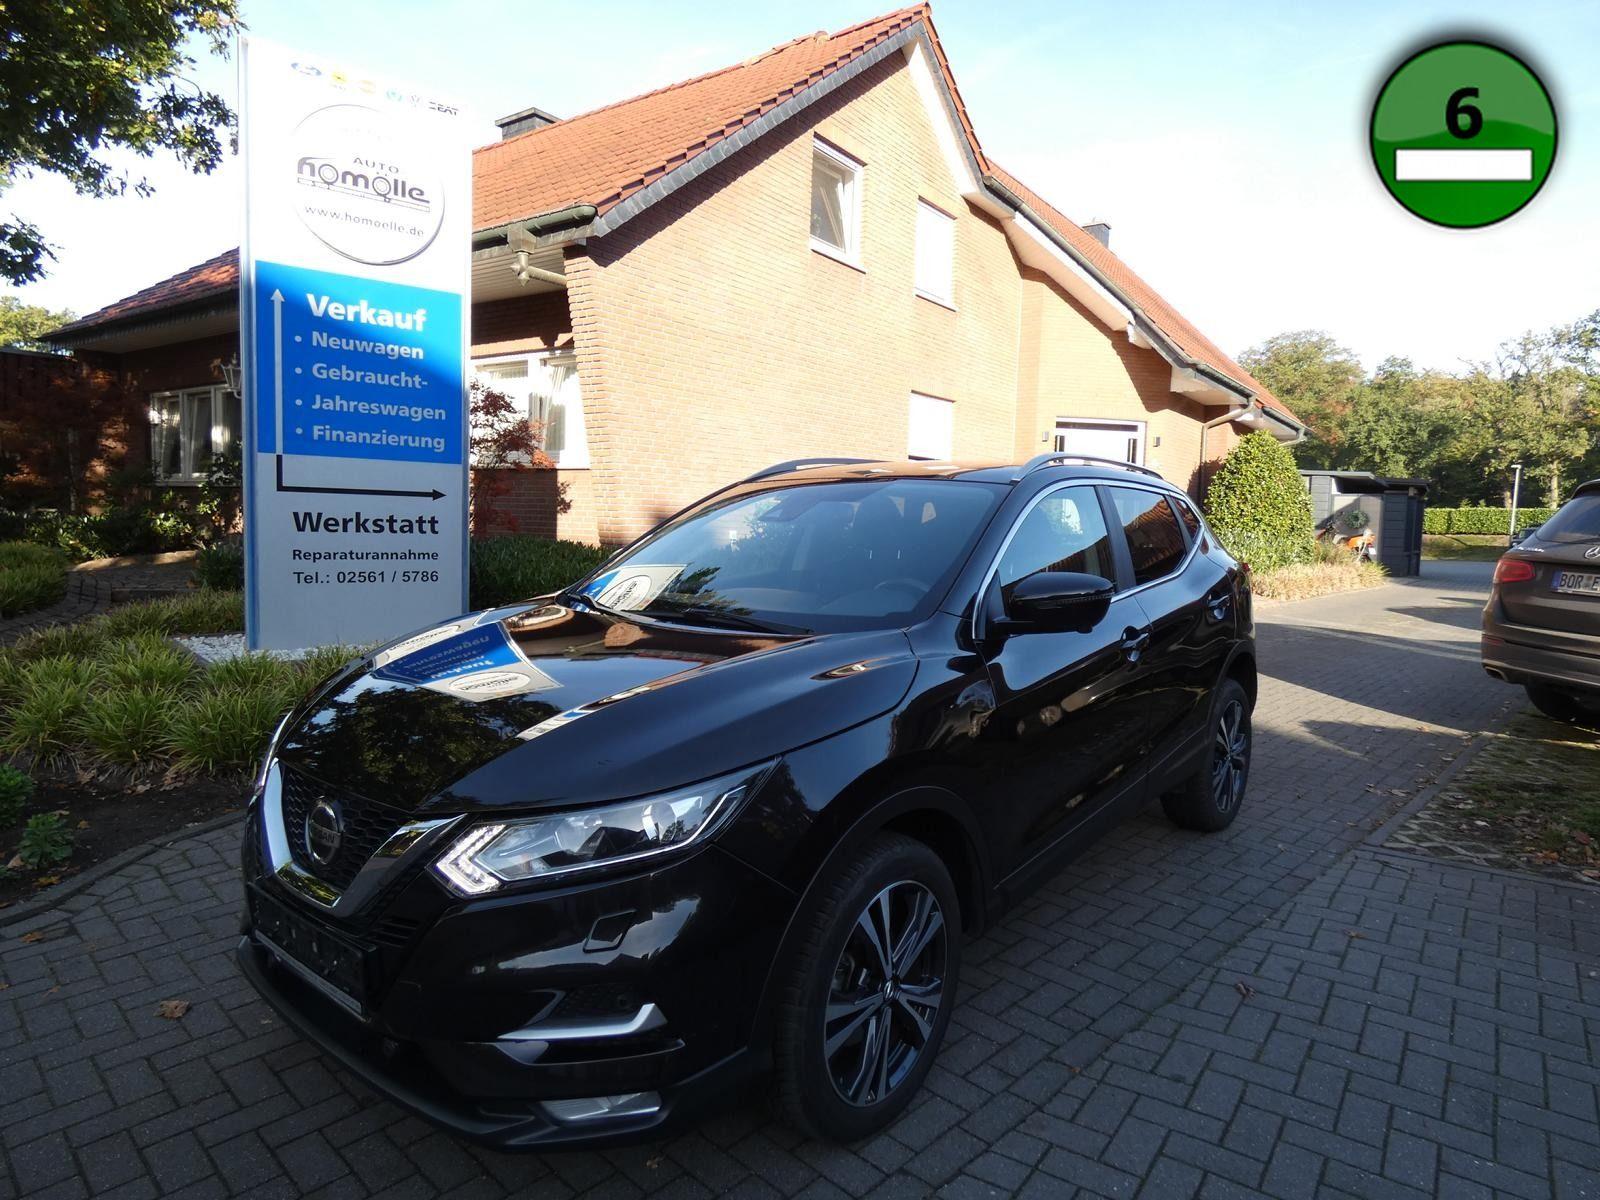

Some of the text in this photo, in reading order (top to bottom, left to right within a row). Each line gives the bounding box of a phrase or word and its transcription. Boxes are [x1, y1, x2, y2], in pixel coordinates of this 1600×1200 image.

[353, 157, 400, 174] AUTO
[304, 205, 425, 237] www.homoelle.de
[306, 293, 428, 332] Verkauf
[311, 331, 424, 360] Neuwagen
[311, 363, 428, 389] Gebraucht-
[311, 394, 446, 422] Jahreswagen
[312, 425, 445, 452] Finanzierung
[292, 511, 439, 535] Werkstatt
[292, 549, 439, 563] Reparaturannahme
[293, 571, 330, 584] Tel.:
[336, 571, 385, 584] 02561
[402, 570, 439, 583] 5786
[1559, 573, 1584, 589] BOR
